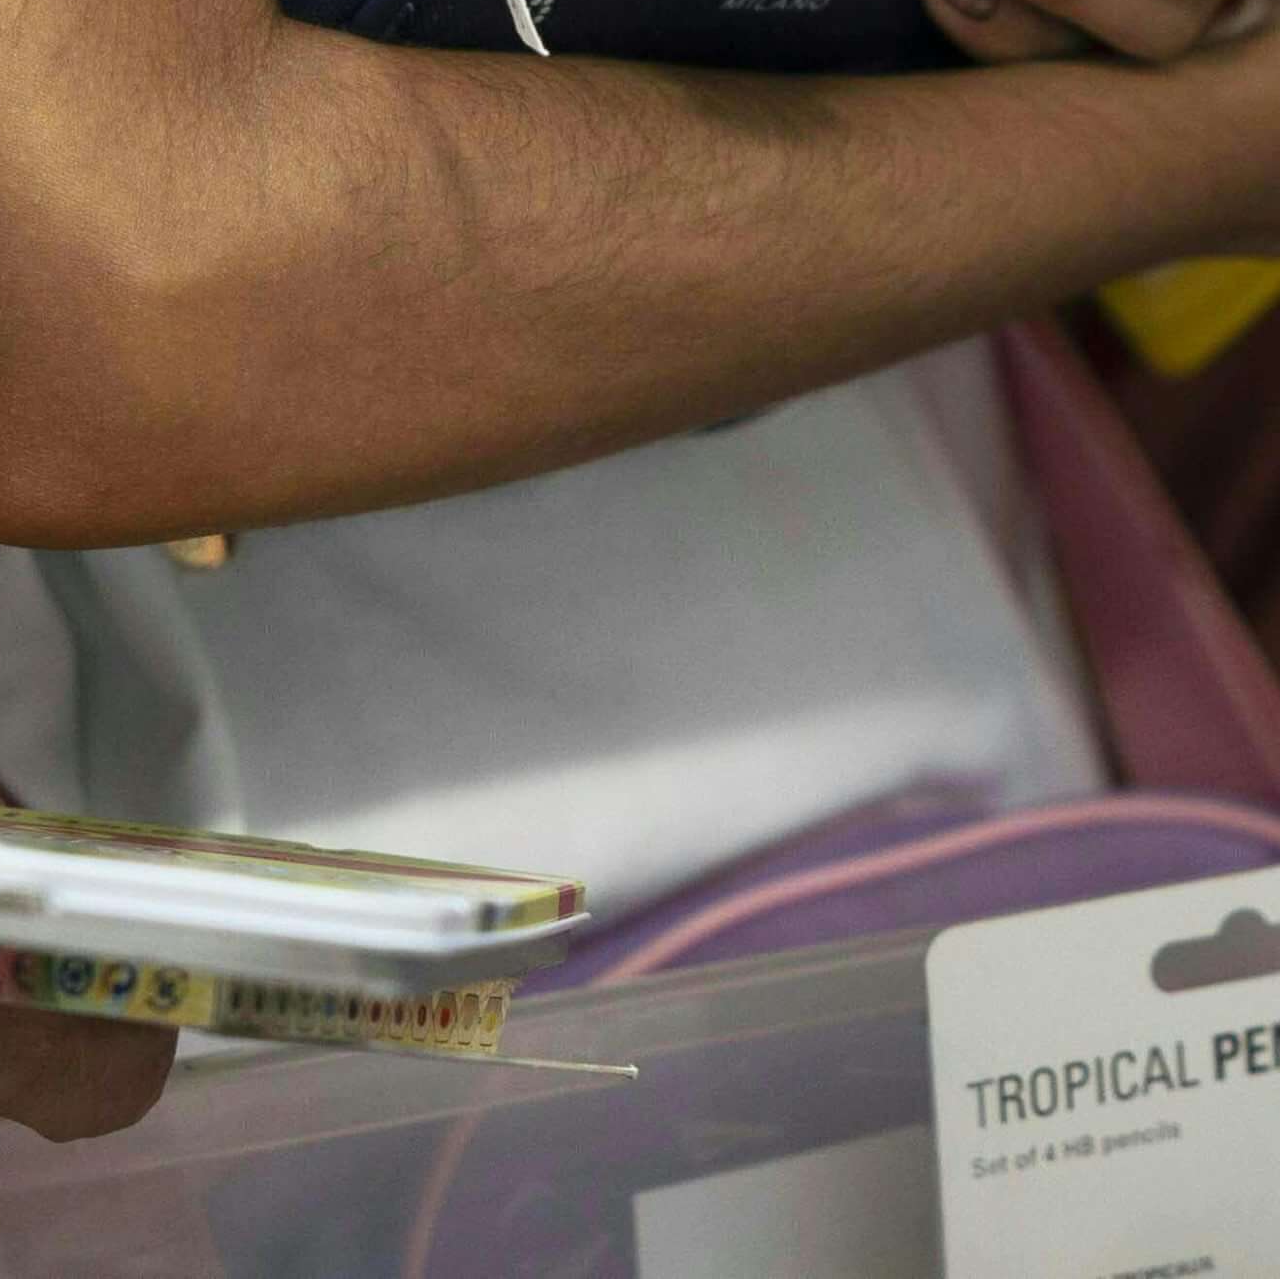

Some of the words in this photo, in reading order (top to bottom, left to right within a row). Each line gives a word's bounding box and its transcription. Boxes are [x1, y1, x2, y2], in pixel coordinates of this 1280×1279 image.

[966, 1039, 1200, 1128] TROPICAL
[972, 1155, 1009, 1180] Set
[1014, 1145, 1038, 1169] of
[1044, 1142, 1056, 1162] 4
[1062, 1133, 1096, 1158] HB
[1101, 1120, 1183, 1157] pencils
